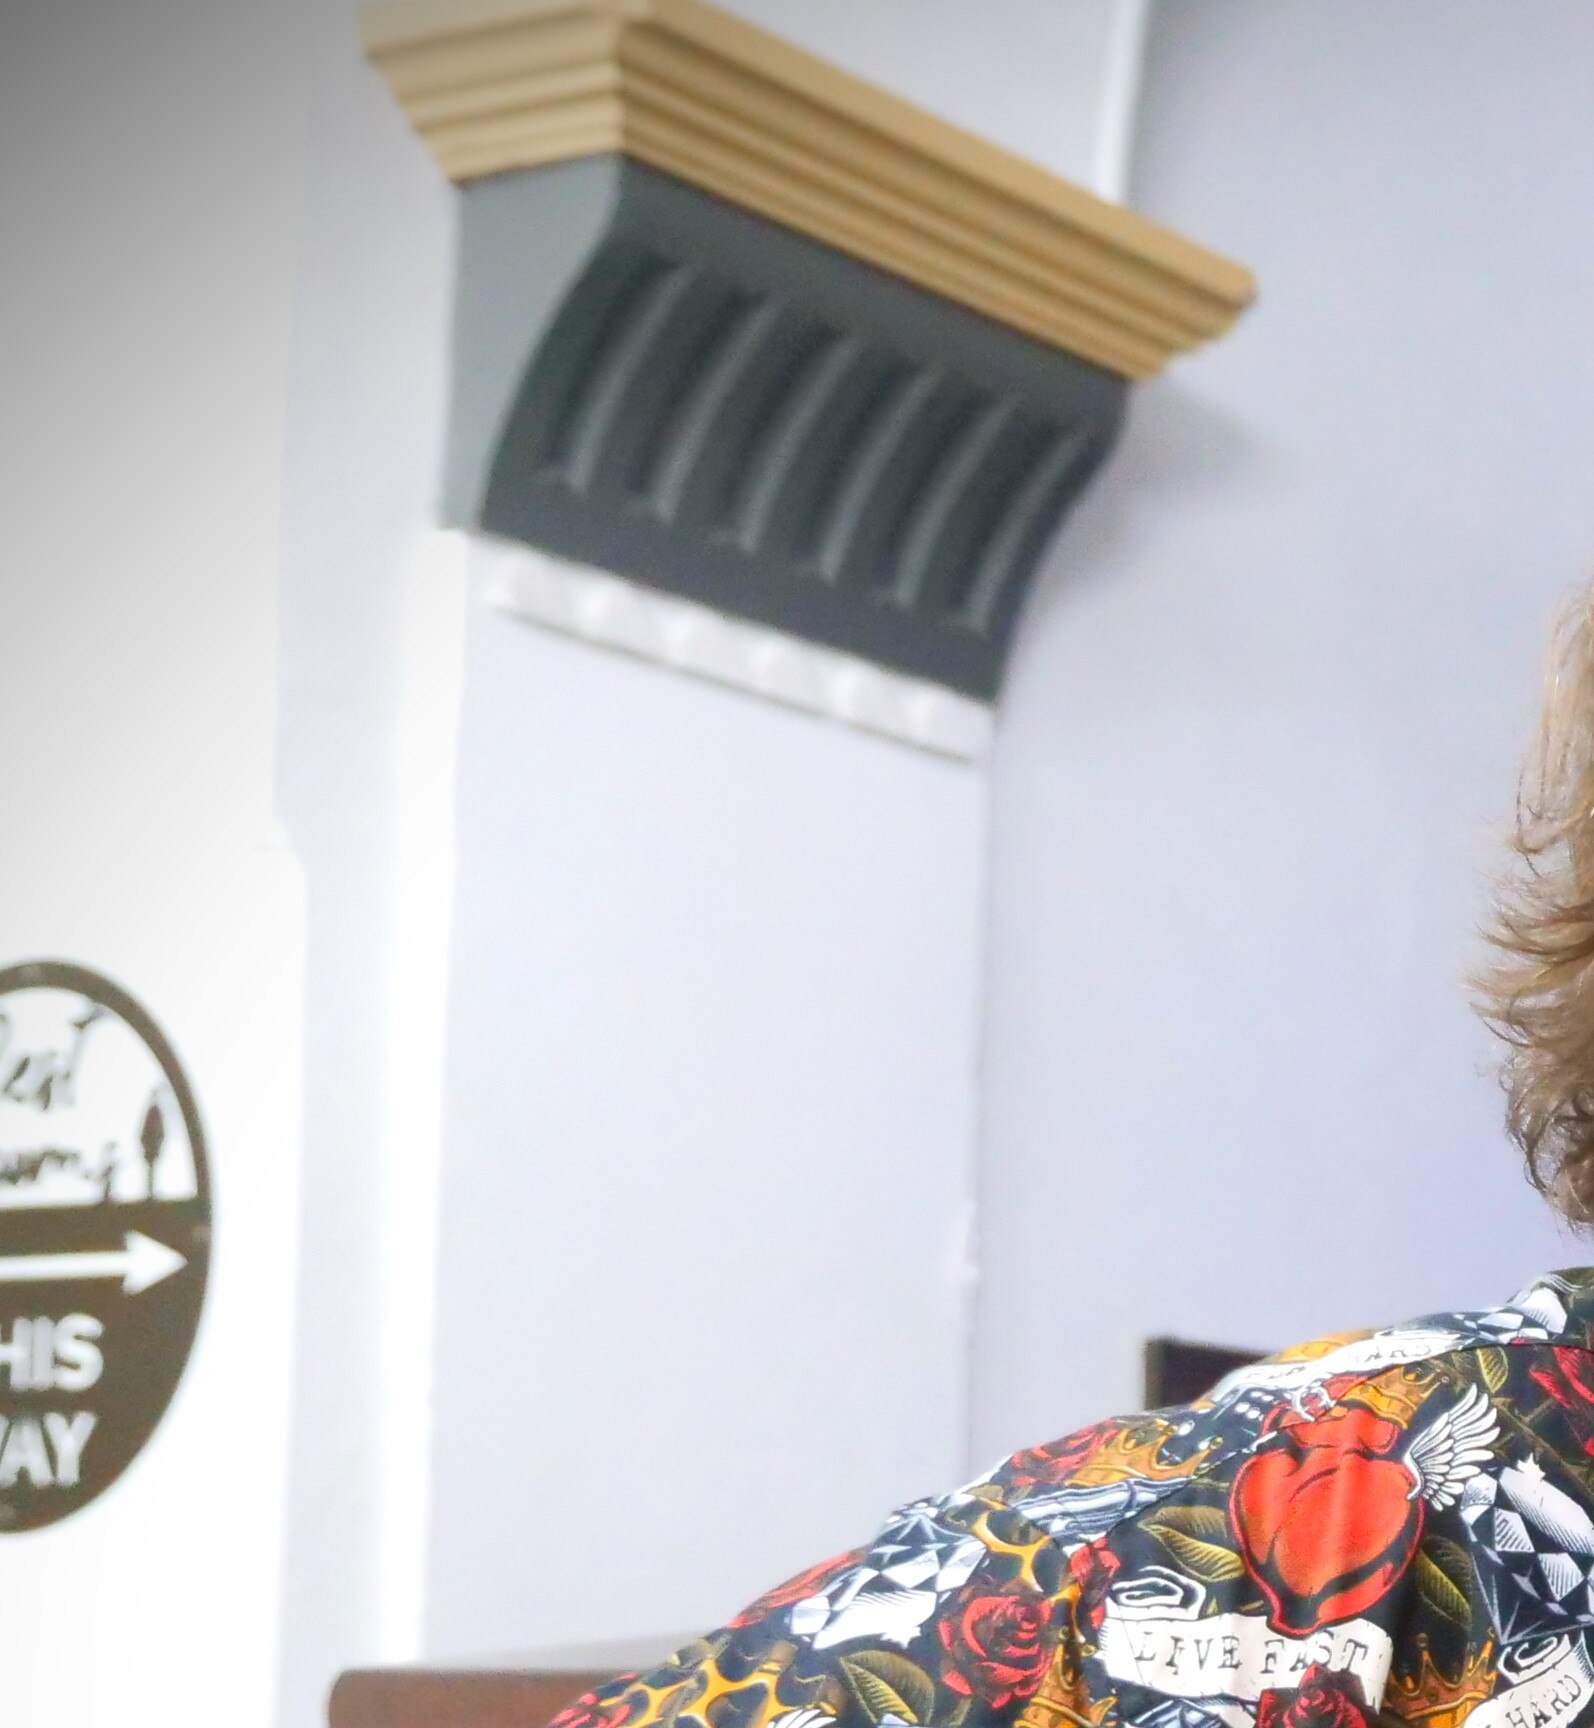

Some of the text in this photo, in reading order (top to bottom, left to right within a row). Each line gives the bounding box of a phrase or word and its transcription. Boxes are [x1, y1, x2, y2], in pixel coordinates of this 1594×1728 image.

[0, 1412, 97, 1488] AY
[1134, 1629, 1370, 1676] LIVE FAST
